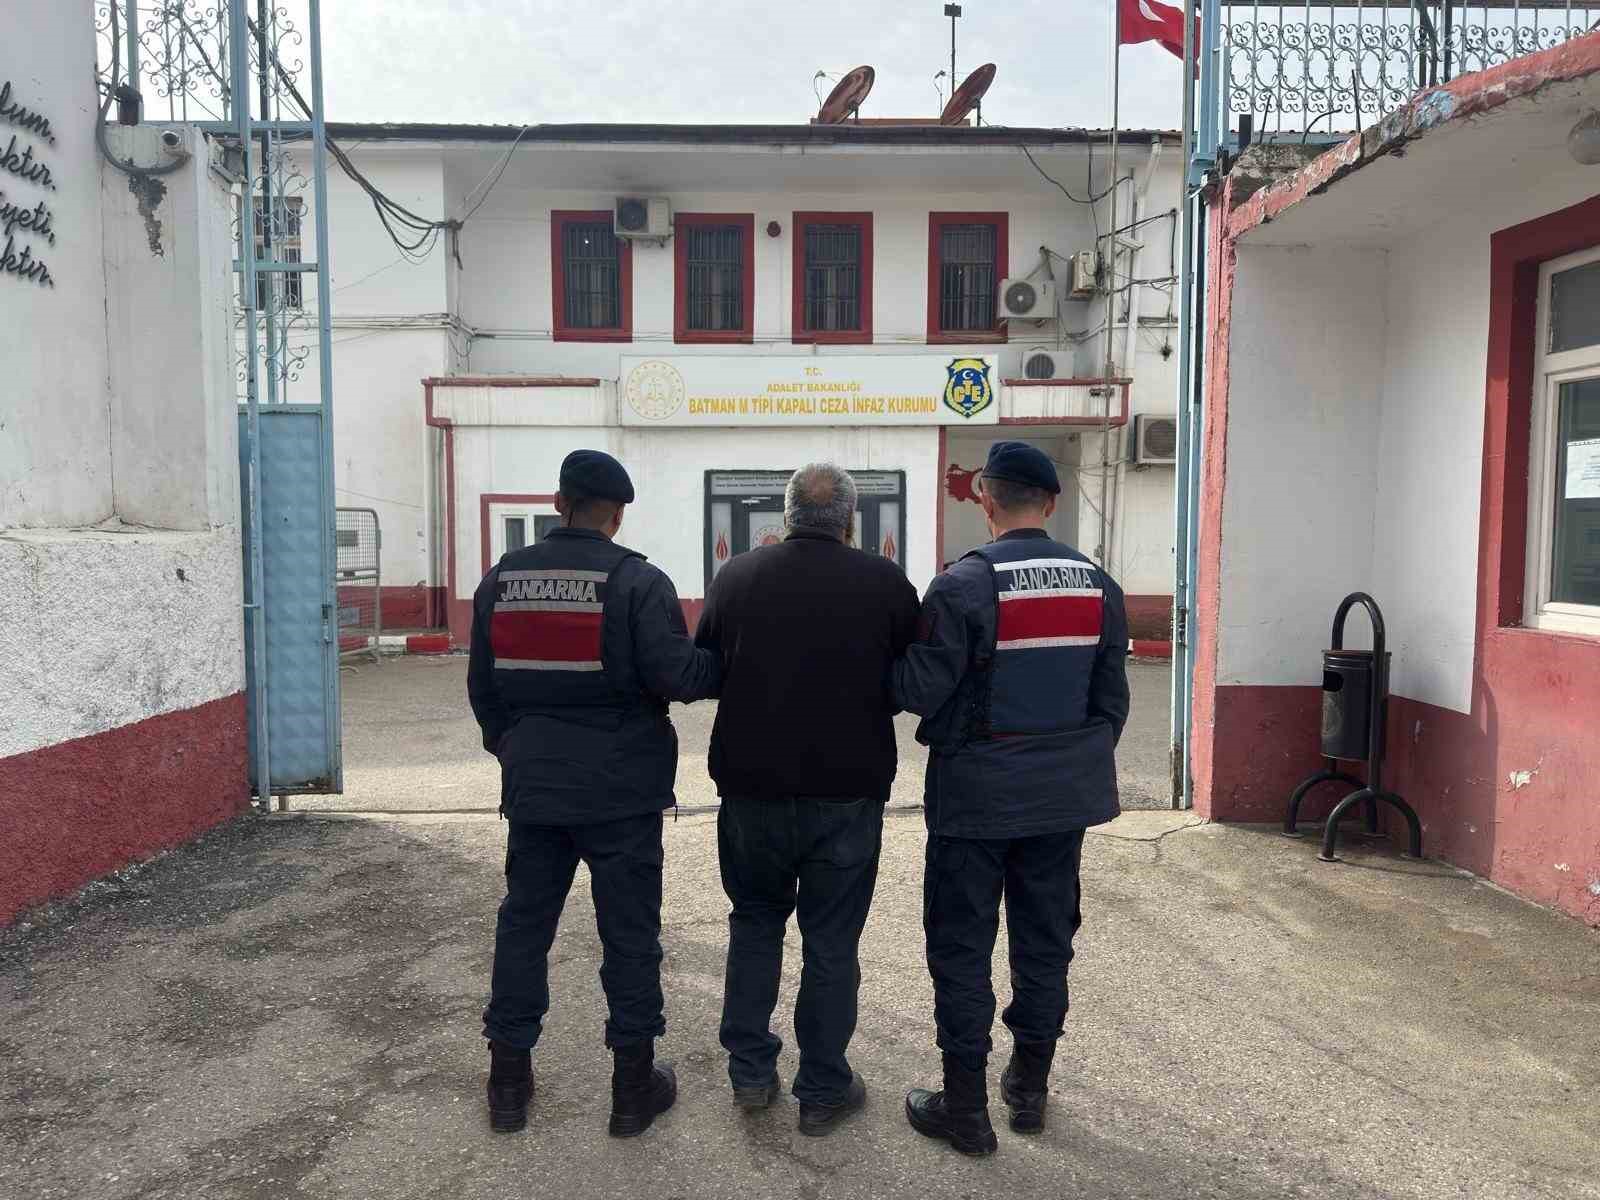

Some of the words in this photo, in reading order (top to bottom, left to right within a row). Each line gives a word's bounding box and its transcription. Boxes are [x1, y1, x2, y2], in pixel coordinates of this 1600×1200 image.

[0, 135, 55, 190] ktur.
[0, 200, 54, 243] yeti,
[767, 383, 803, 393] ADALET
[688, 398, 736, 415] BATMAN
[738, 398, 748, 415] M
[777, 397, 817, 415] KAPALI
[820, 397, 849, 414] CEZA
[852, 393, 885, 414] İNFAZ
[888, 395, 937, 413] KURUMU
[1009, 567, 1094, 591] JANDARMA
[501, 580, 597, 602] JANDARMA
